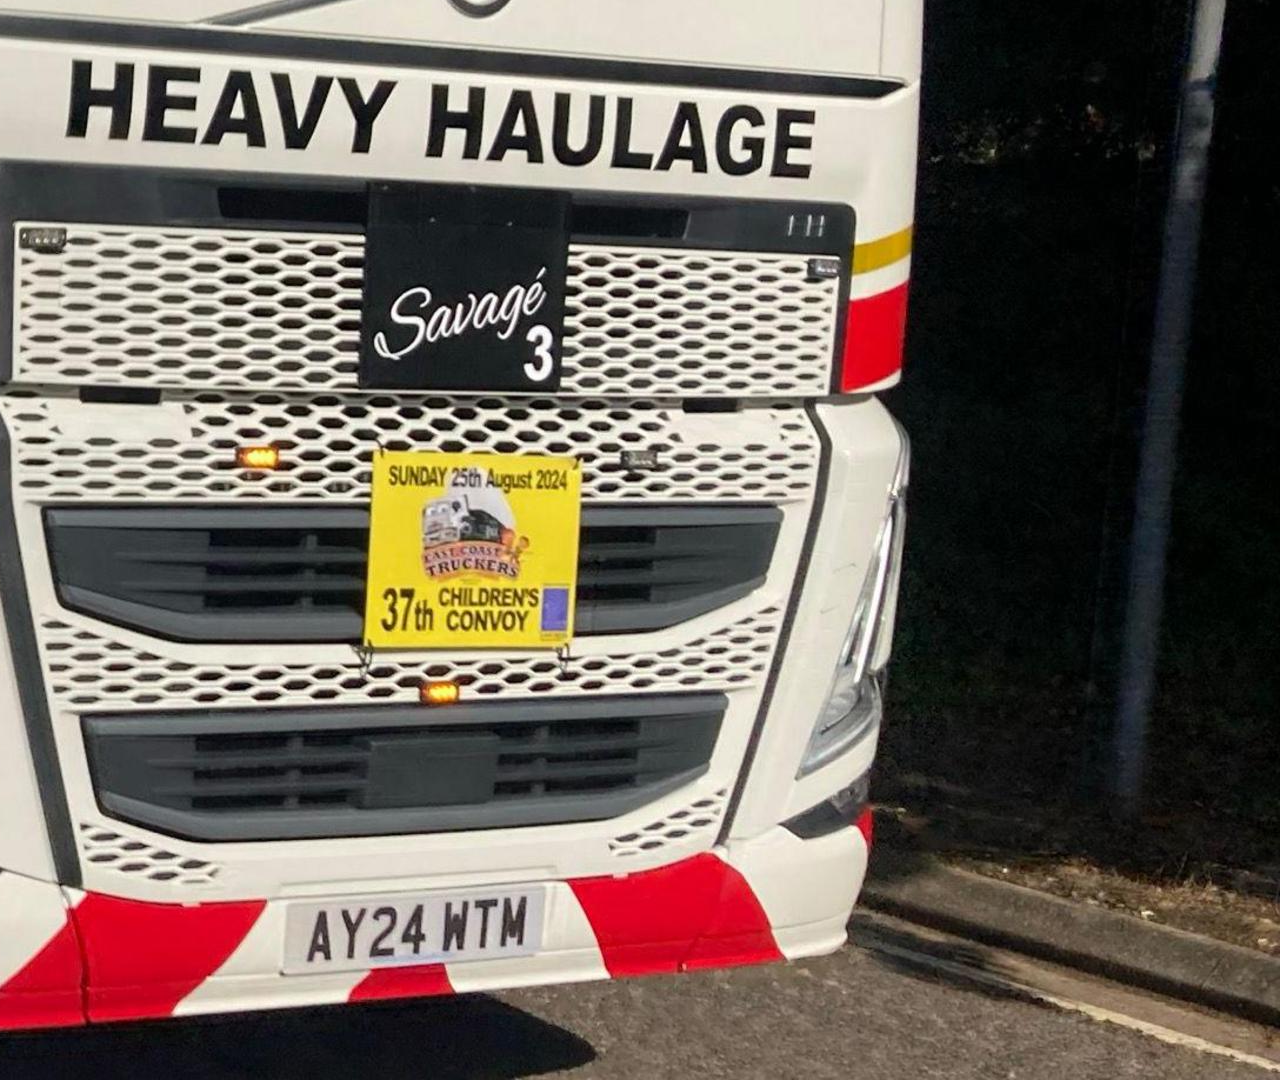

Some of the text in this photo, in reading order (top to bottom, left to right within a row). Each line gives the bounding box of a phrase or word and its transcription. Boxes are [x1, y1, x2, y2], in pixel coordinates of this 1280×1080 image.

[65, 59, 817, 180] HEAVY HAULAGE
[373, 266, 548, 361] Savagé
[523, 324, 554, 382] 3
[388, 465, 568, 493] SUNDAY 25th August 2024
[426, 558, 518, 578] TRUCKERS
[380, 587, 434, 632] 37th
[439, 587, 539, 608] CHILDREN'S
[446, 610, 529, 631] CONVOY
[306, 895, 528, 962] AY24 WTM
